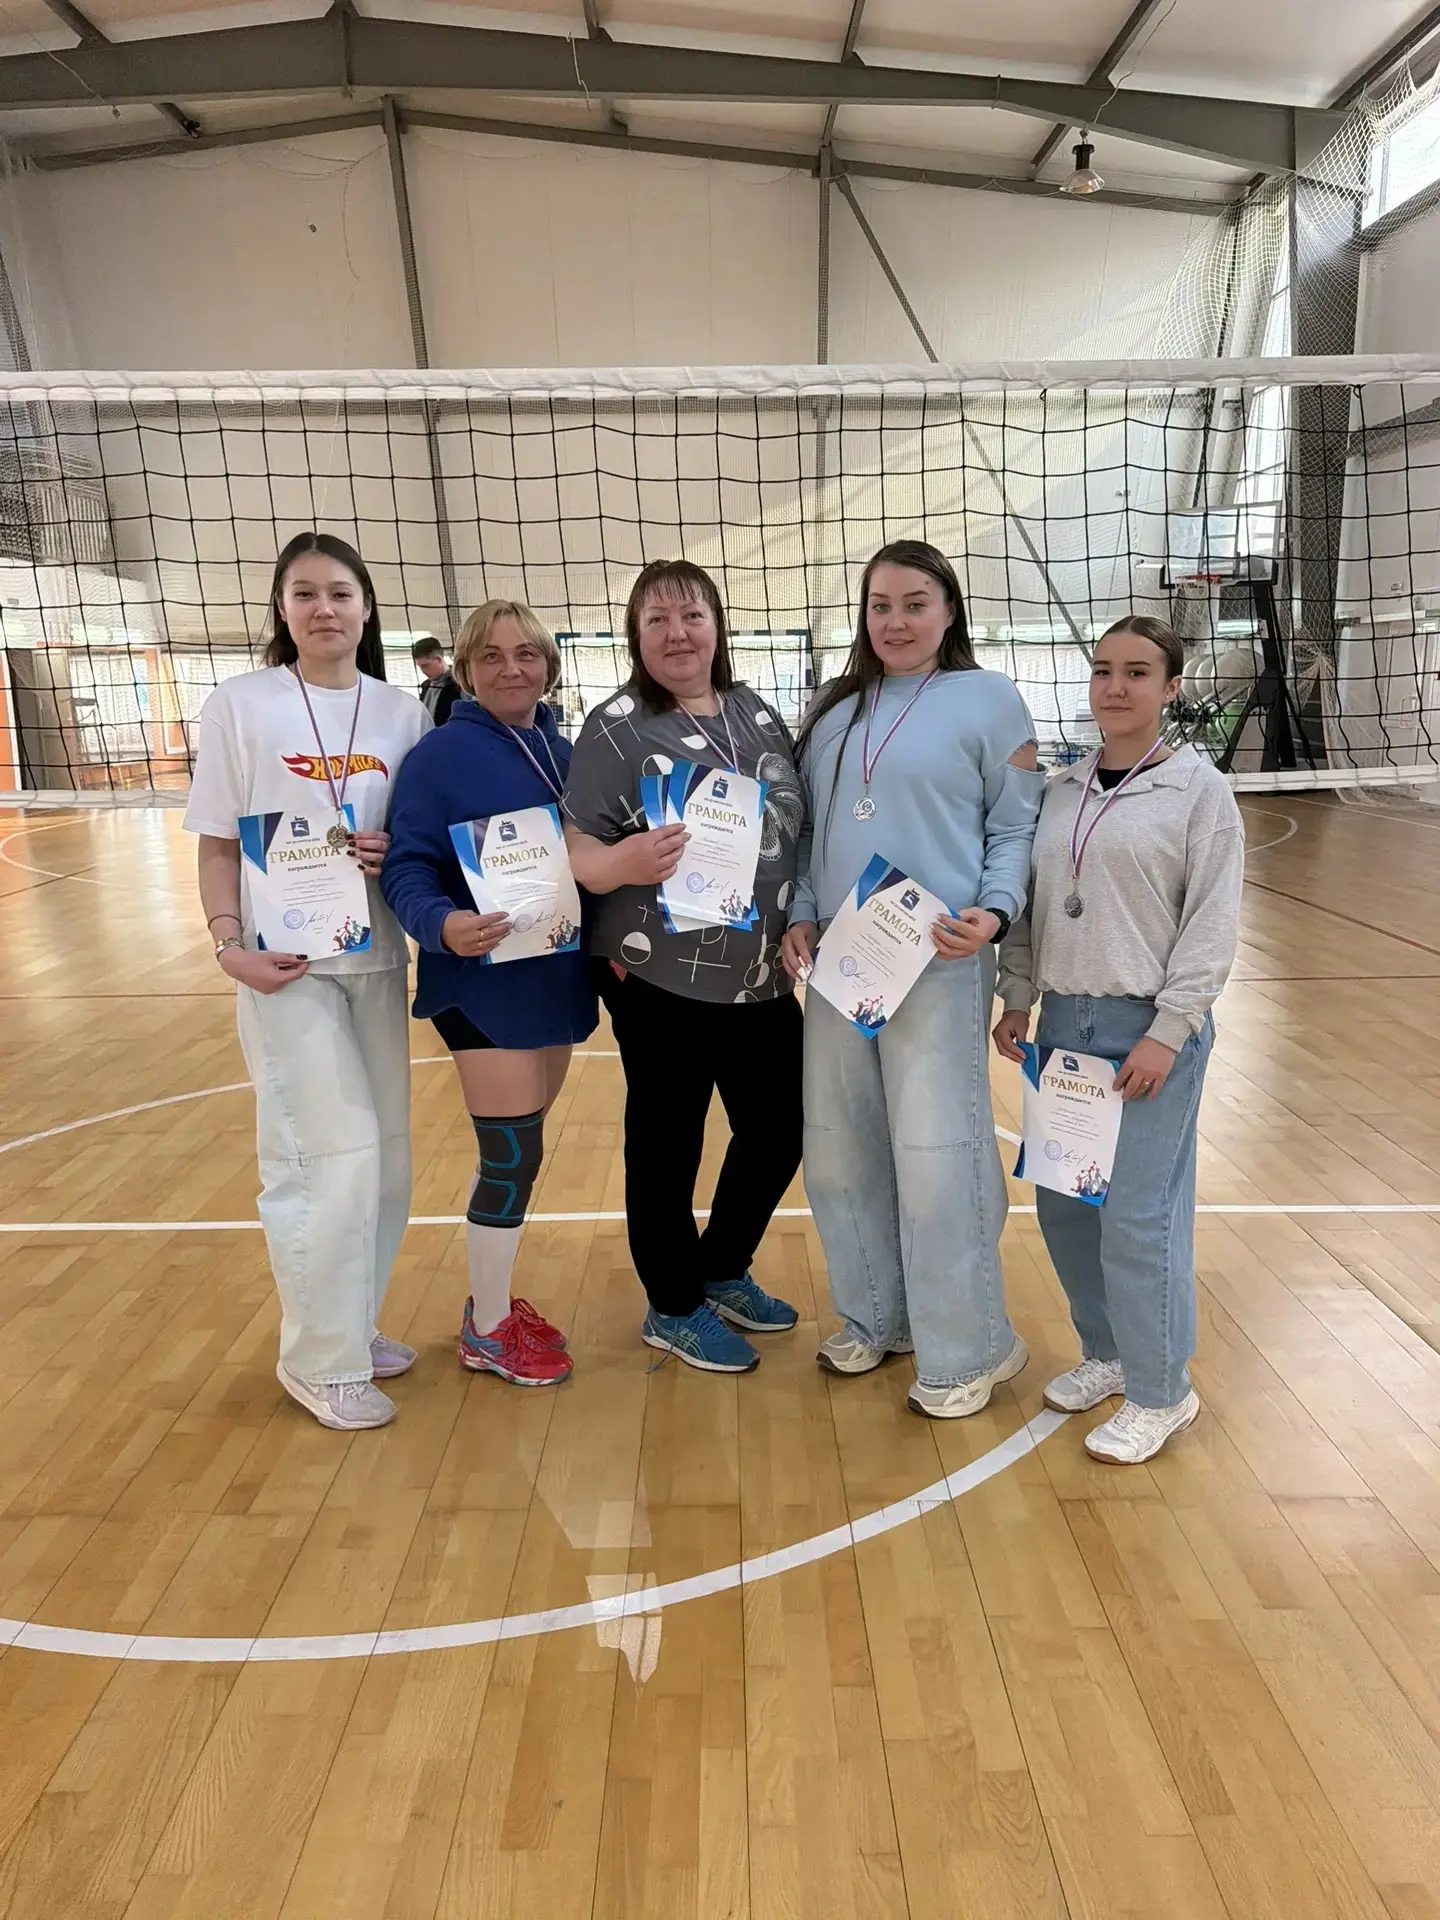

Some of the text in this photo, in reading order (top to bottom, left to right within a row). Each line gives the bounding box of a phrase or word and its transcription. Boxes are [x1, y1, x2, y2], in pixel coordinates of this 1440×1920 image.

[687, 802, 747, 828] ГРАМОТА
[269, 845, 341, 864] ГРАМОТА
[483, 845, 550, 869] ГРАМОТА
[287, 862, 328, 873] награждается
[866, 896, 923, 948] ГРАМОТА
[872, 919, 902, 945] награждается
[1042, 1074, 1107, 1099] ГРАМОТА
